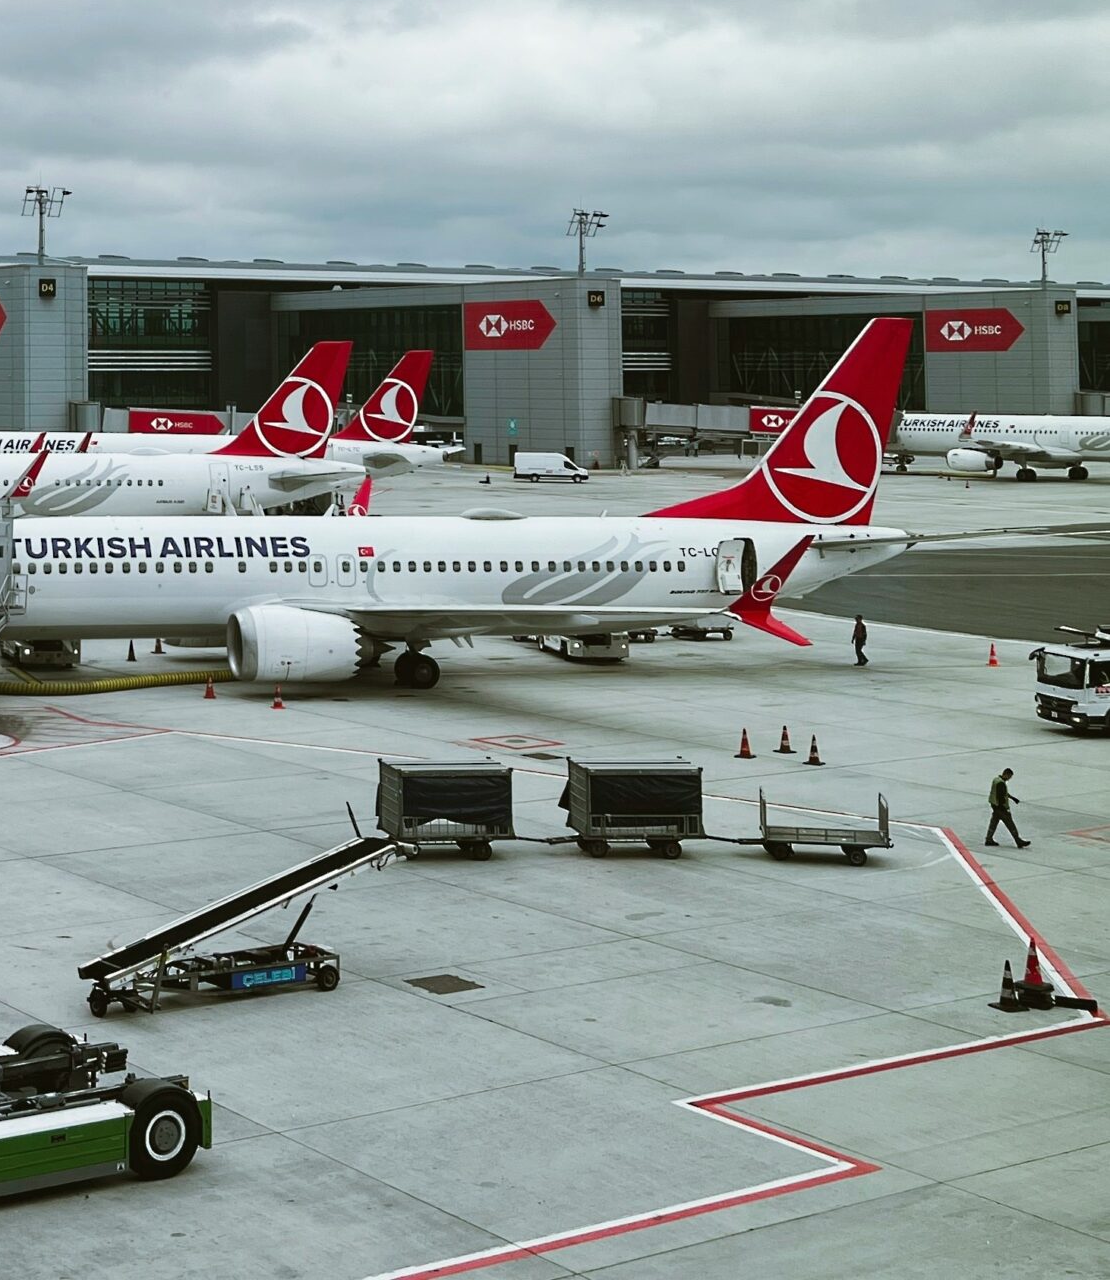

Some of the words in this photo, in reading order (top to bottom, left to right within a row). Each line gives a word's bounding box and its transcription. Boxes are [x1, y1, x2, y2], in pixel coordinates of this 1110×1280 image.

[41, 283, 54, 293] D4
[590, 294, 603, 303] D6
[509, 319, 535, 331] HSBC
[974, 324, 1002, 335] HSBC
[3, 439, 77, 451] AIRNES
[12, 537, 152, 559] TURKISH
[159, 536, 311, 558] AIRLINES
